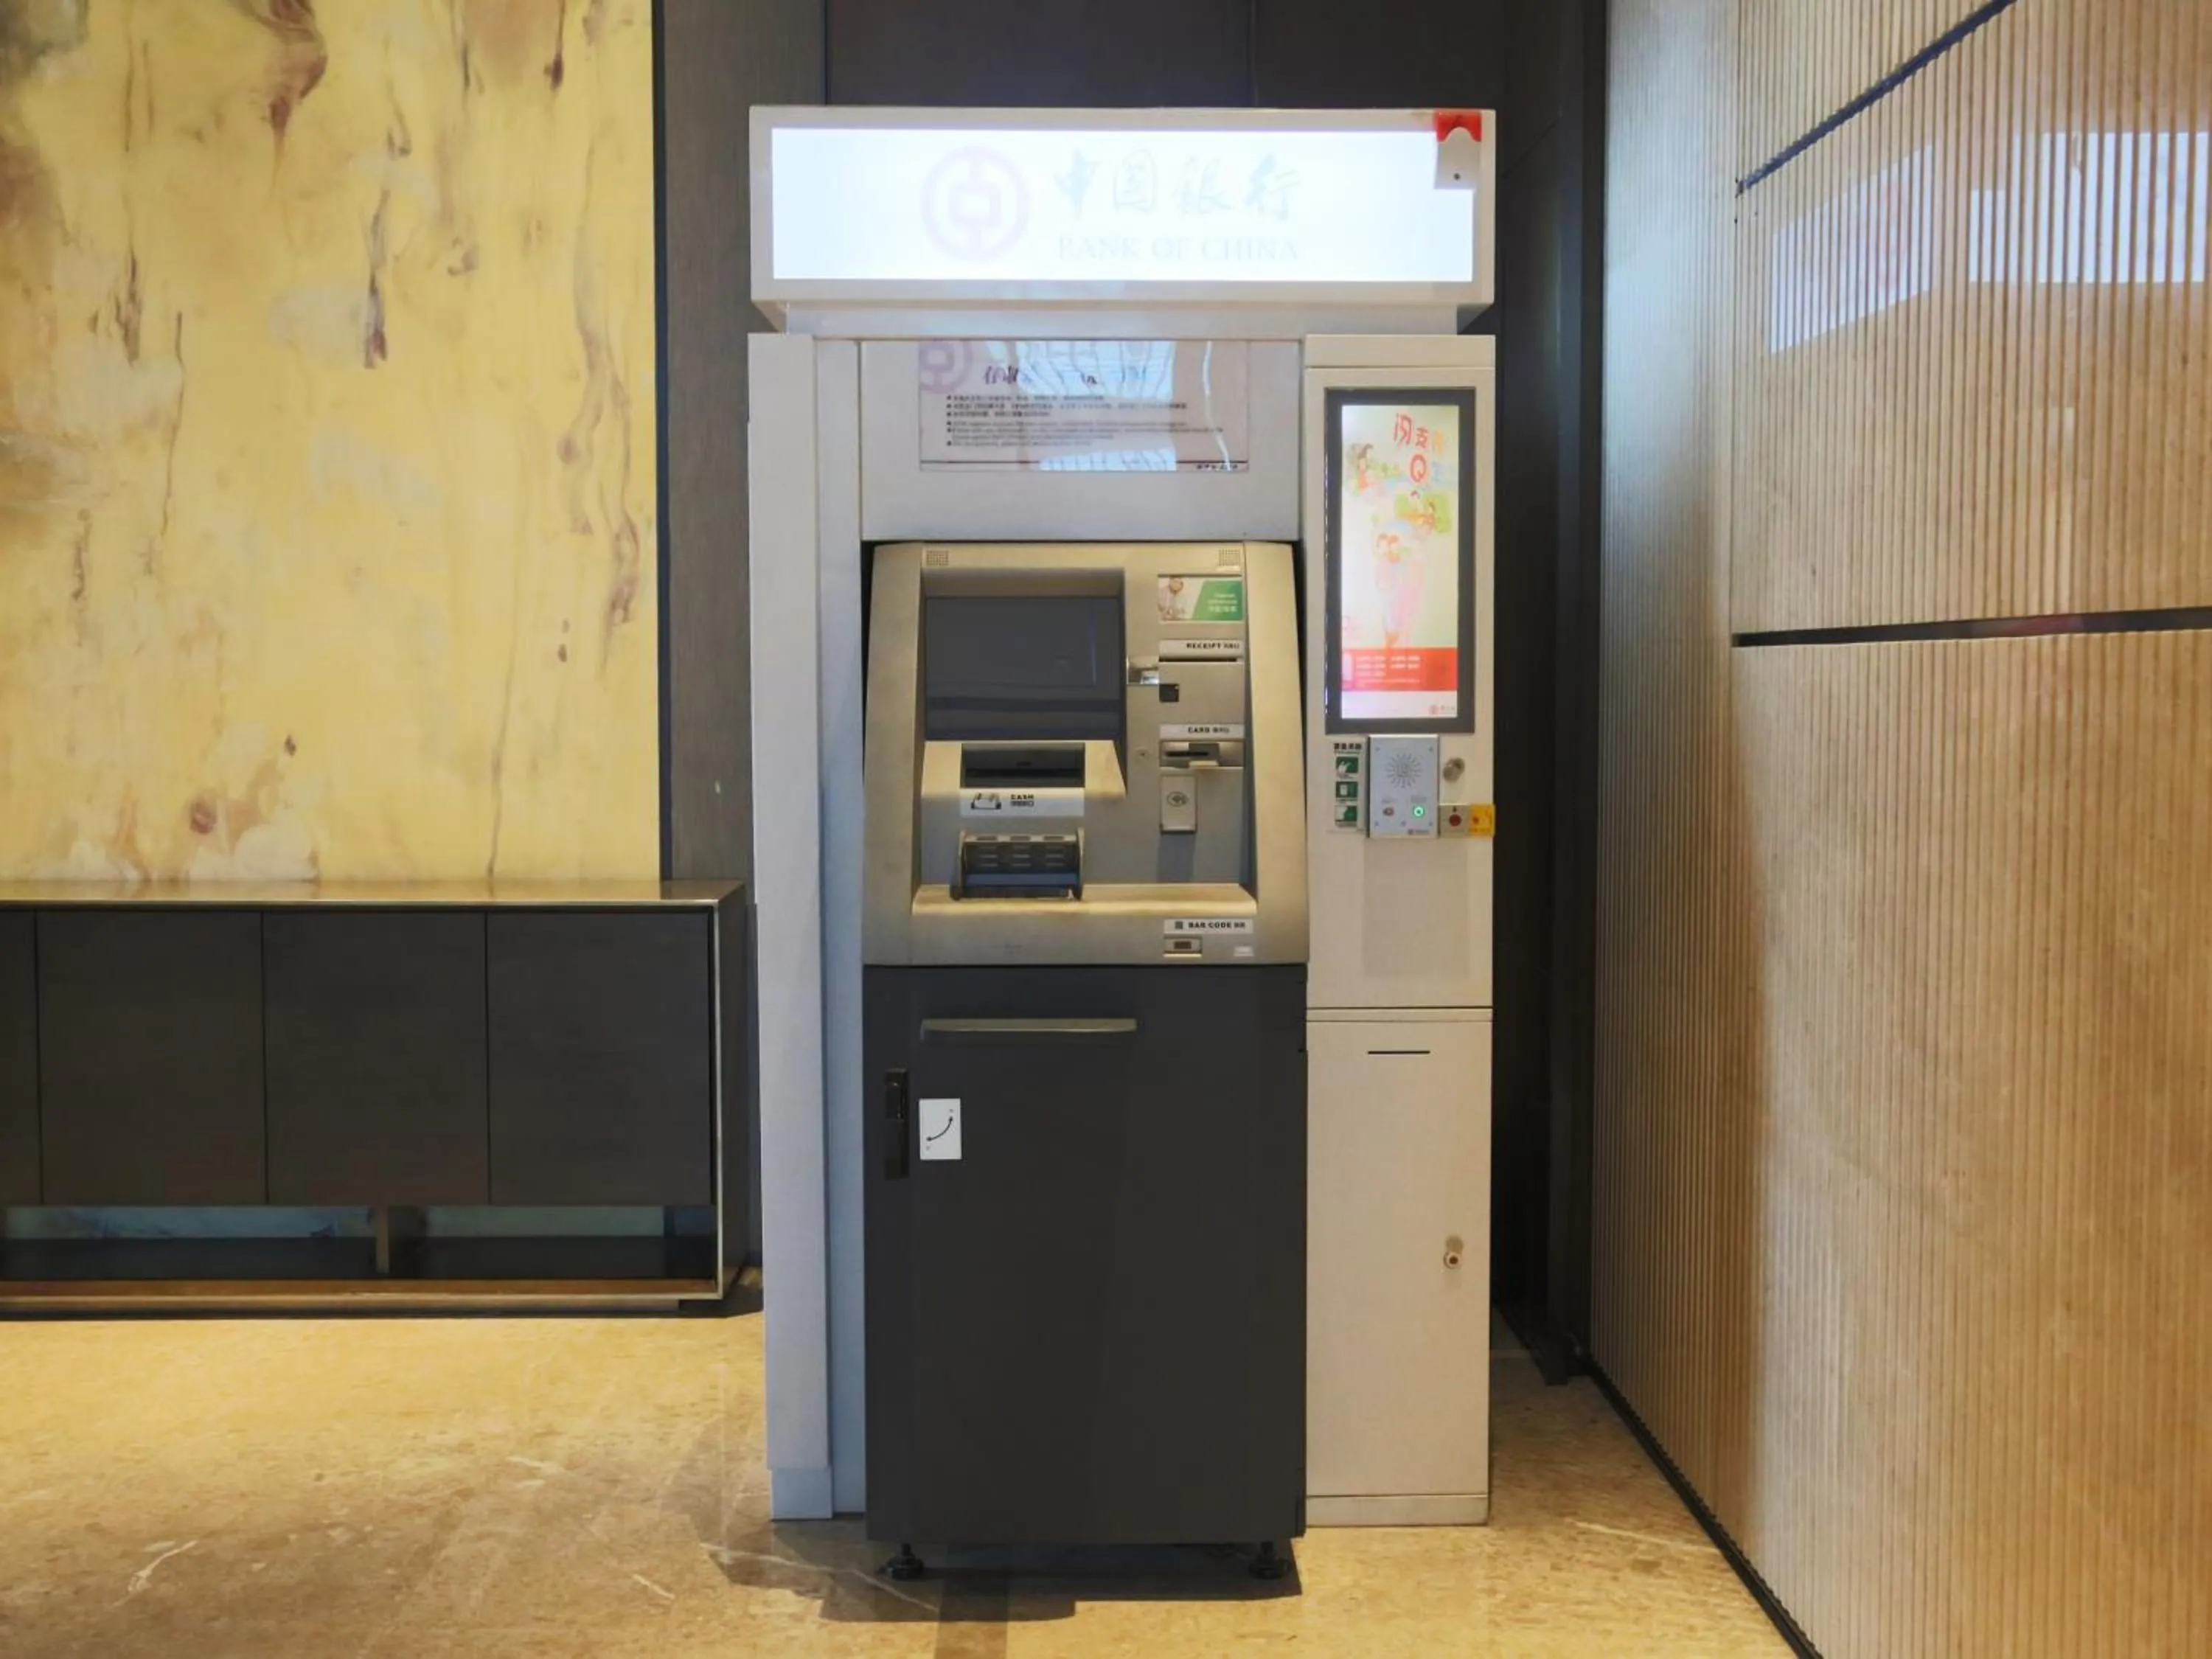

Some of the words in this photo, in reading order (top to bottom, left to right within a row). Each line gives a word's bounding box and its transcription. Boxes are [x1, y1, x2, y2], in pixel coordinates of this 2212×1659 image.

[1059, 236, 1141, 260] BANK
[1151, 237, 1189, 261] OF
[1201, 237, 1300, 262] CHINA
[1186, 641, 1221, 650] RECEIPT
